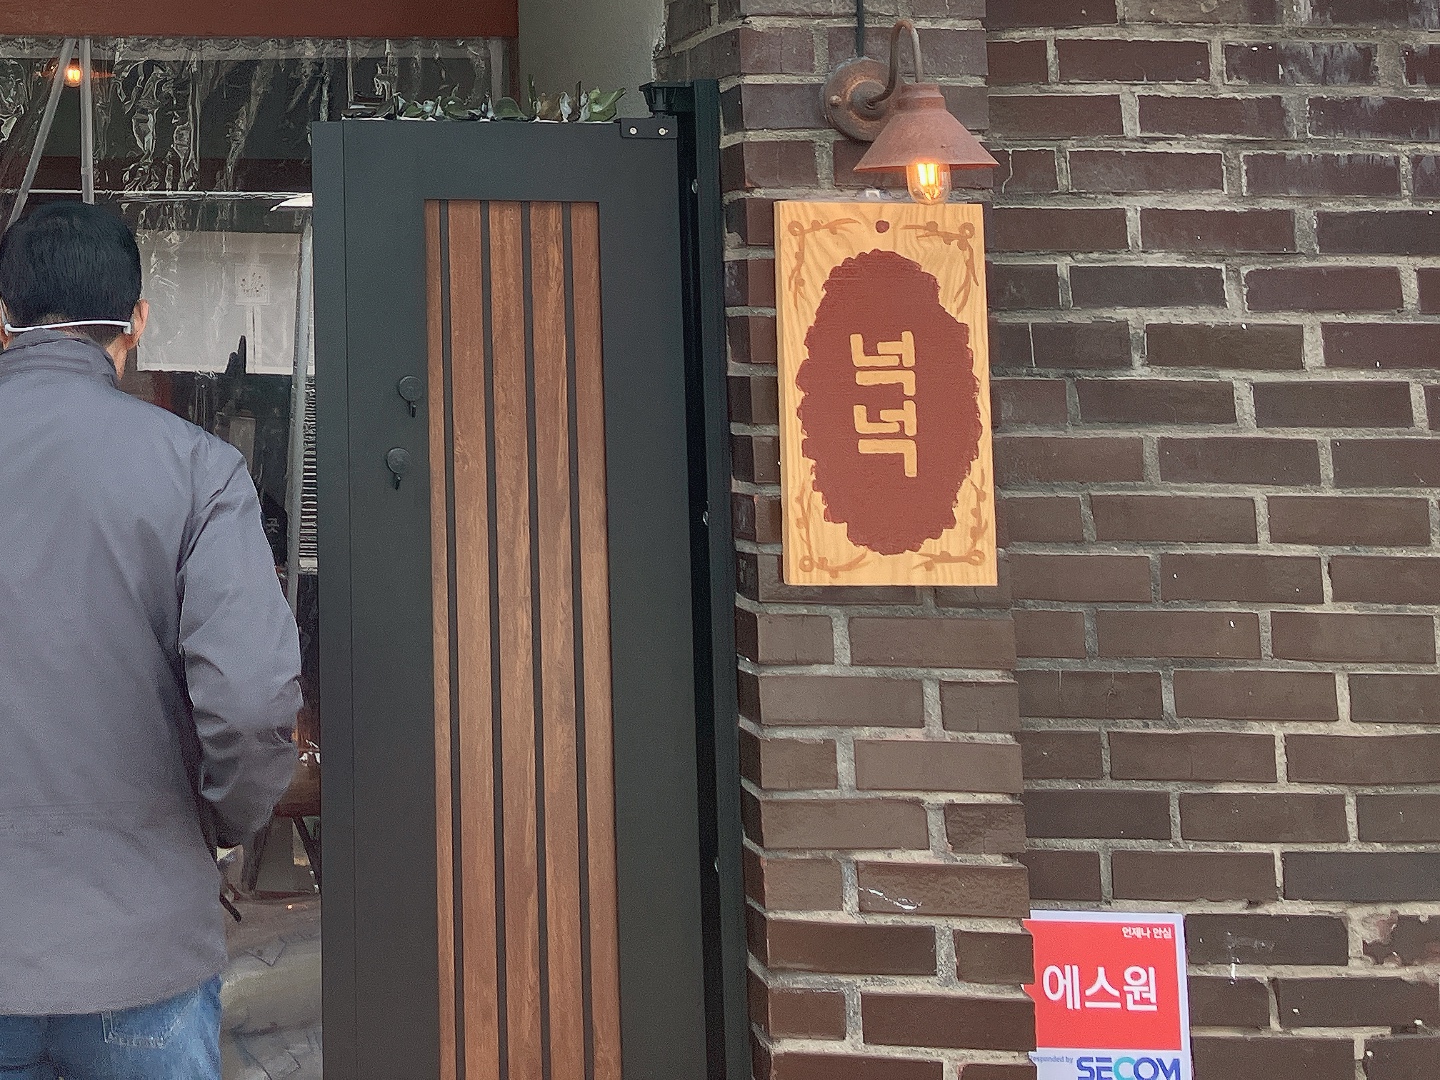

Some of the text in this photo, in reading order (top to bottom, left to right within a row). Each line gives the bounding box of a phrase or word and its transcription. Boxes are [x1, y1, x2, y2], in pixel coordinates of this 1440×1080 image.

[1121, 926, 1172, 939] 언제나 안심
[1042, 964, 1158, 1012] 에스원
[1030, 1055, 1065, 1064] esponded
[1076, 1056, 1182, 1080] SECOM
